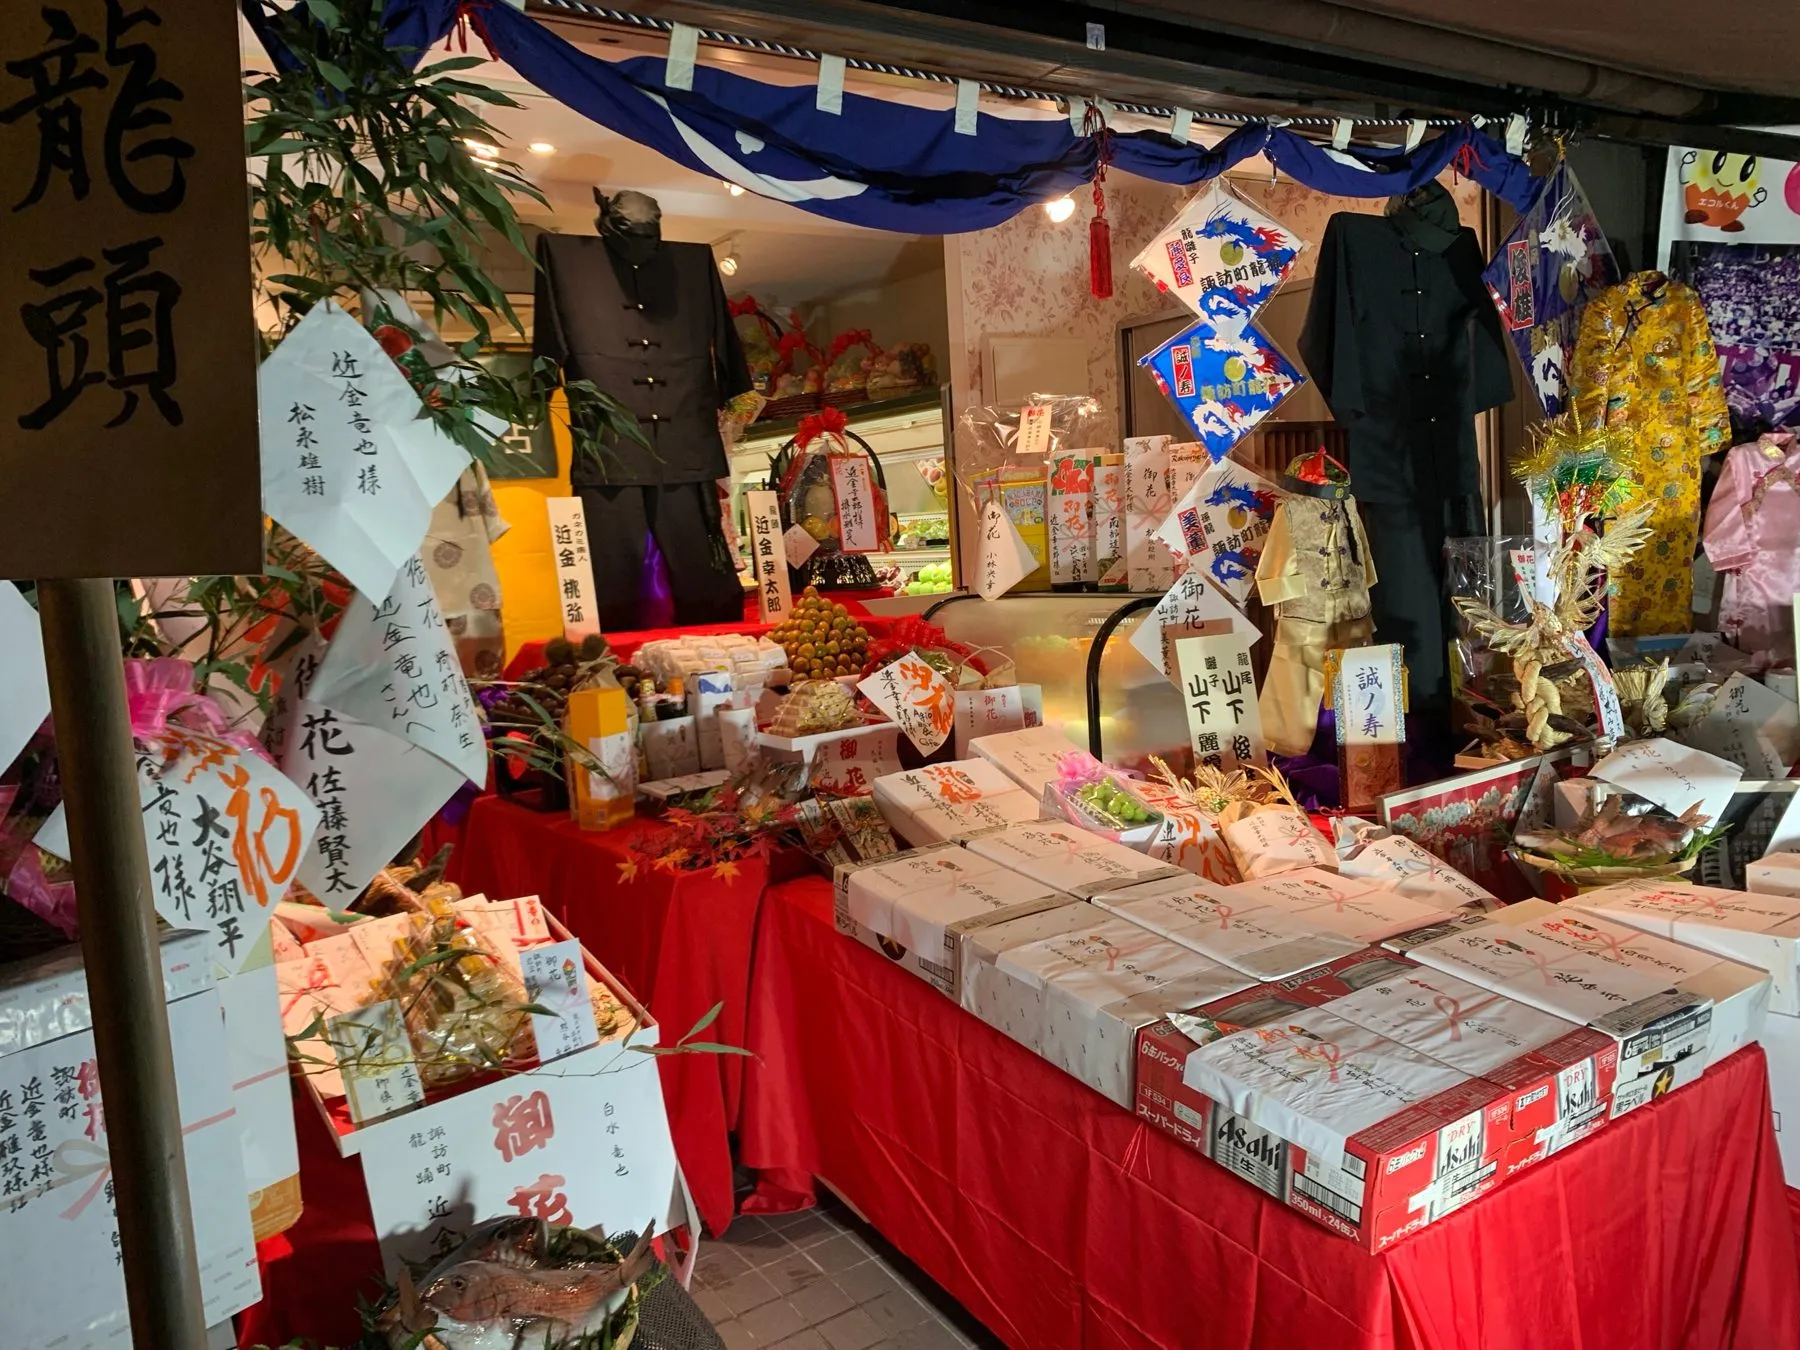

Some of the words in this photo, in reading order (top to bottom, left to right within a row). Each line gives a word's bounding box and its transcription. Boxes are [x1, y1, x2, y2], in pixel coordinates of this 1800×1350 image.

[0, 5, 196, 430] 龍頭
[1698, 197, 1740, 211] エコルくん
[1175, 348, 1193, 394] 誠ノ寿
[1143, 467, 1158, 498] 御花
[987, 510, 1002, 542] 御花
[755, 515, 782, 613] 近金幸太郎
[1181, 576, 1205, 631] 御花
[1237, 652, 1253, 686] 龍尾
[985, 695, 999, 722] 御花
[1355, 666, 1385, 739] 誠ノ寿
[839, 739, 867, 786] 御花
[306, 765, 359, 895] 佐藤賢太
[191, 794, 245, 960] 大谷翔平
[1138, 1103, 1201, 1148] スーパードライ
[1218, 1115, 1282, 1172] Asahi
[427, 1125, 452, 1177] 諏訪町
[1441, 1132, 1481, 1176] Asahi
[1291, 1193, 1361, 1242] 350ml×24缶入
